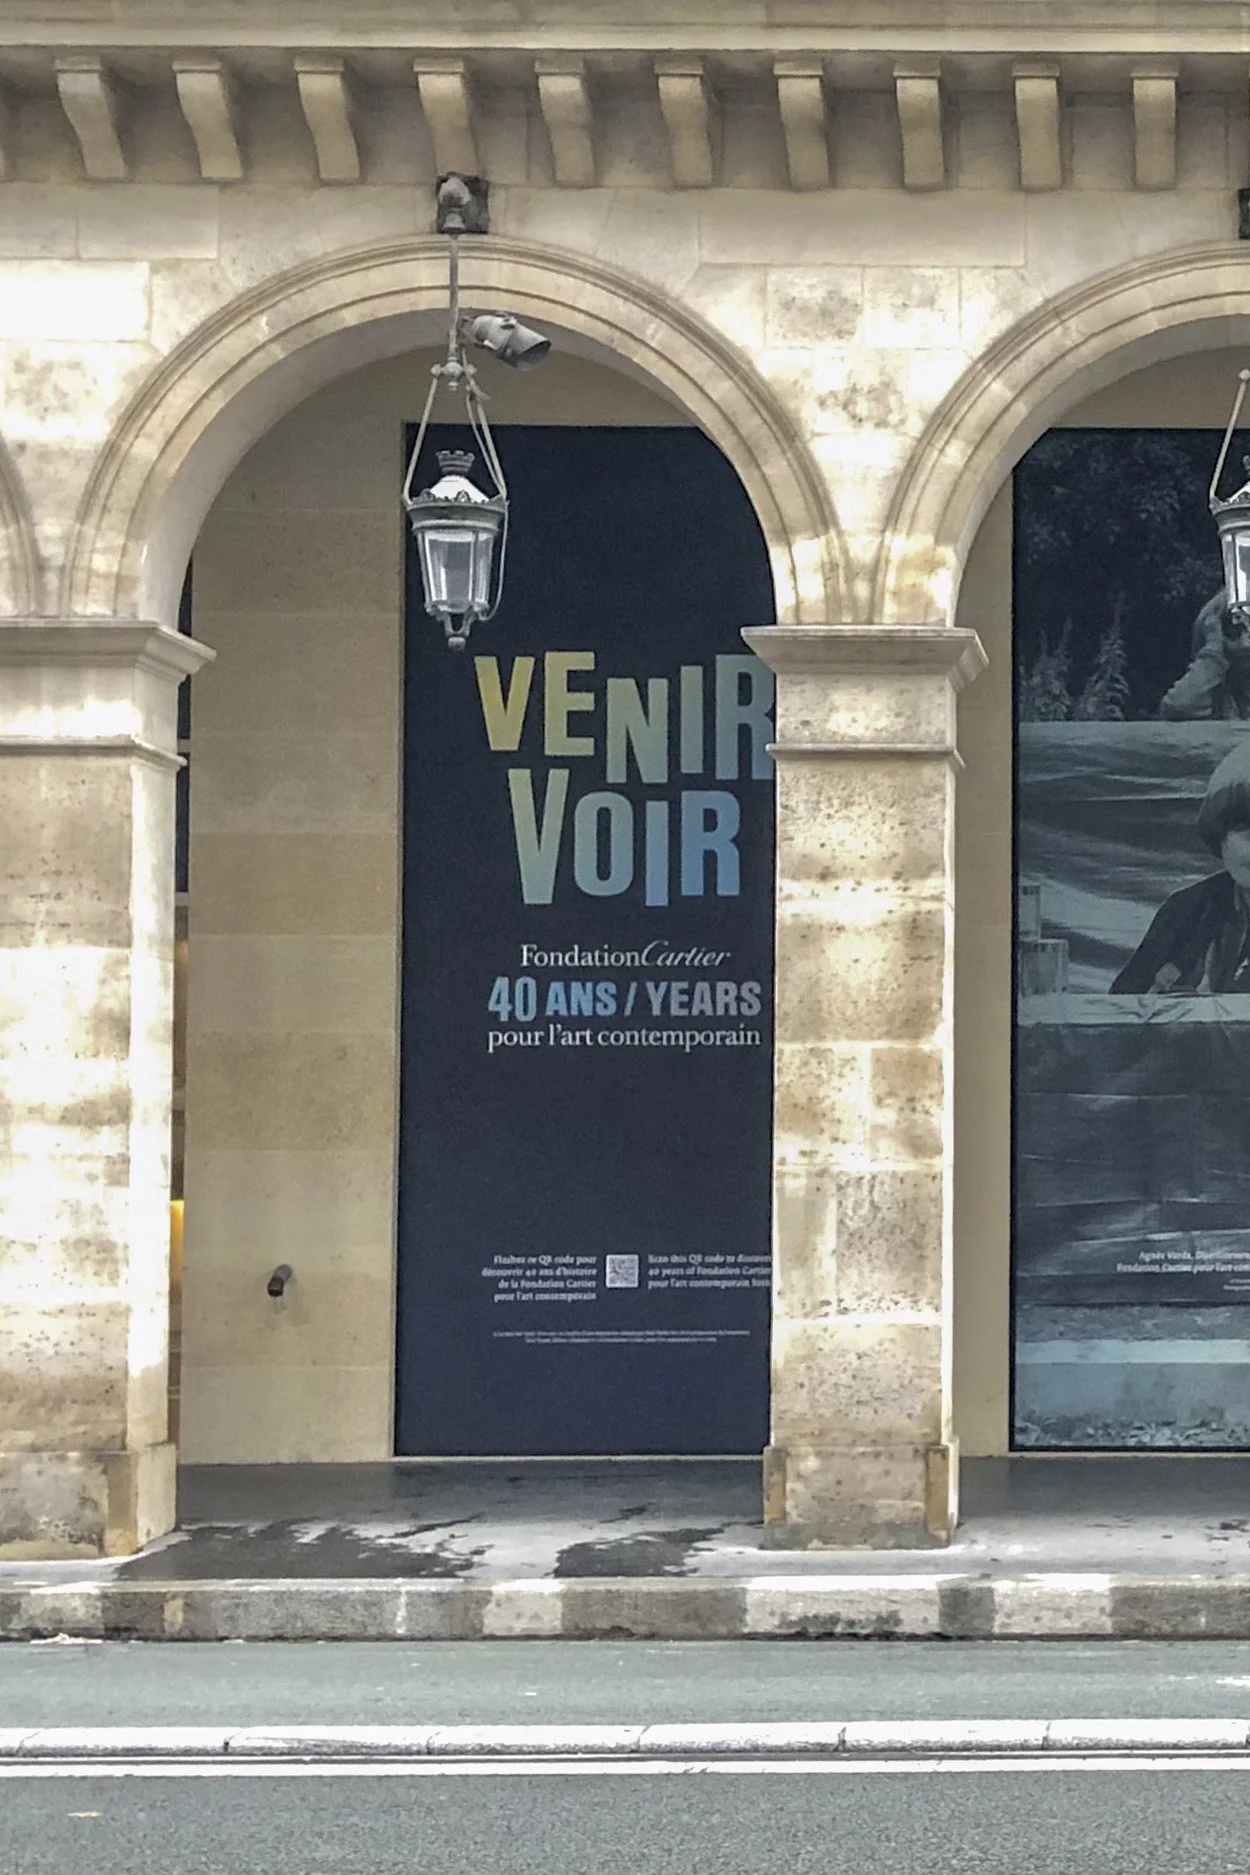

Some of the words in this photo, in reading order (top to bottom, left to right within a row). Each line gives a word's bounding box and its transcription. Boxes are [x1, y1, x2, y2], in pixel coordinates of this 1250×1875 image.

[474, 651, 774, 784] VENIR
[508, 768, 740, 907] VOIR
[487, 976, 537, 1022] 40
[545, 981, 617, 1017] ANS
[645, 980, 762, 1017] YEARS
[487, 1029, 545, 1053] pour
[548, 1024, 594, 1047] l'art
[597, 1024, 761, 1053] contemporain
[539, 1255, 552, 1266] QR
[554, 1254, 574, 1264] code
[576, 1256, 597, 1266] pour
[688, 1254, 703, 1265] QR
[704, 1253, 725, 1263] code
[539, 1268, 554, 1276] ans
[661, 1268, 684, 1278] years
[697, 1266, 740, 1275] Fondation
[1117, 1263, 1161, 1272] Fondation
[1162, 1263, 1192, 1272] Cartier
[1193, 1264, 1214, 1274] pour
[498, 1280, 509, 1288] de
[511, 1279, 518, 1288] la
[520, 1280, 564, 1288] Fondation
[566, 1279, 596, 1288] Cartier
[648, 1280, 669, 1290] pour
[689, 1279, 750, 1290] contemporain
[494, 1293, 515, 1303] pour
[516, 1291, 533, 1300] l'art
[535, 1291, 597, 1302] contemporain
